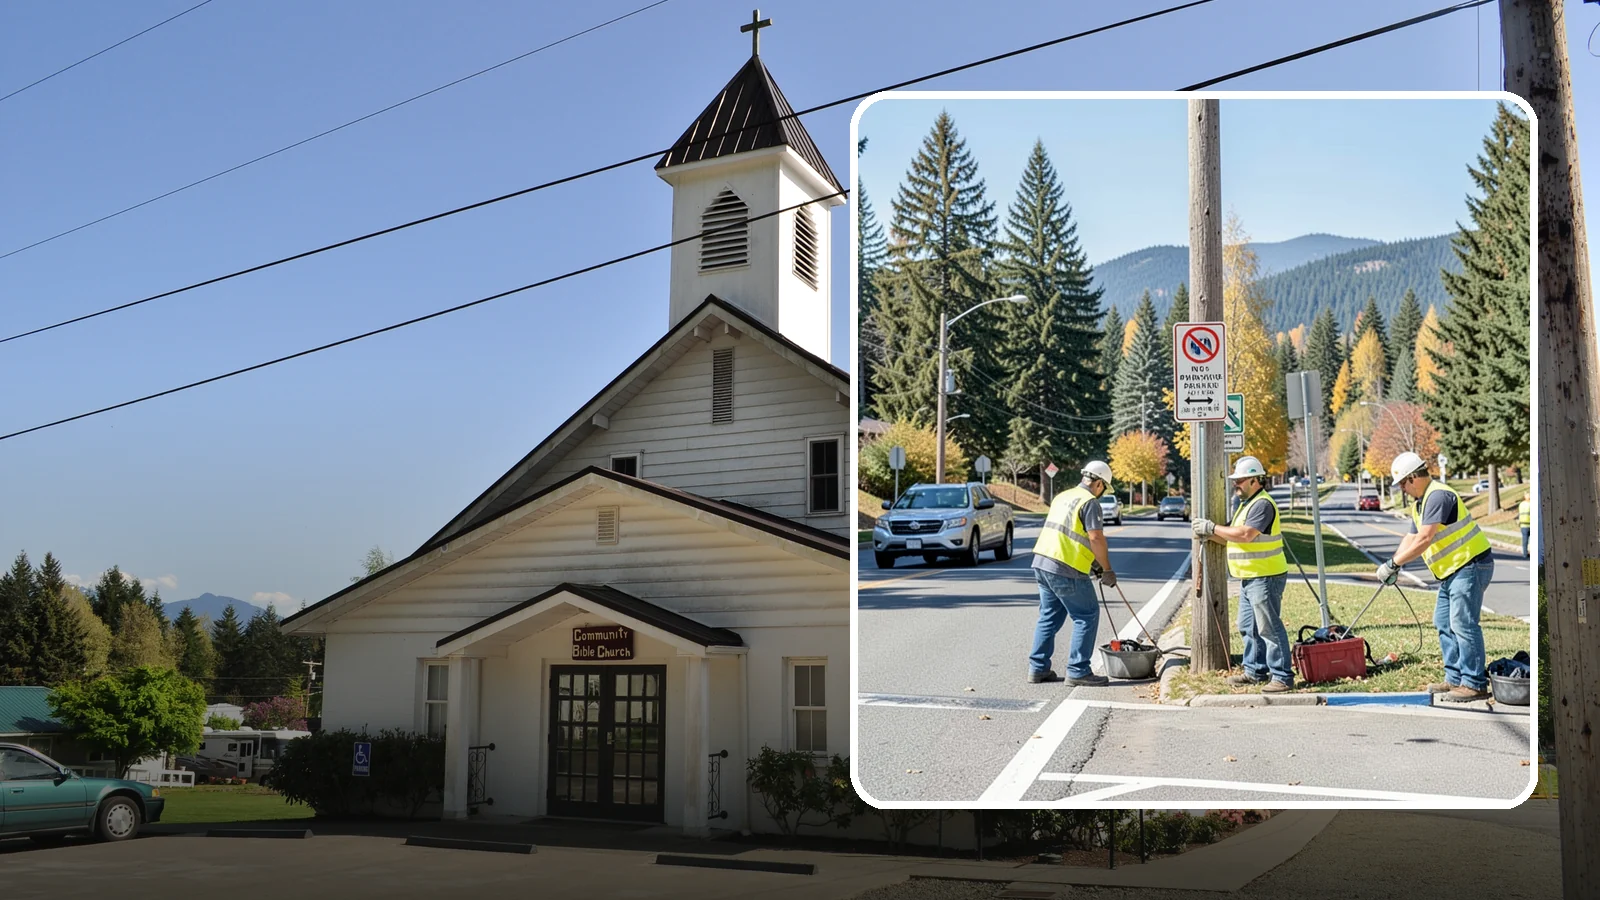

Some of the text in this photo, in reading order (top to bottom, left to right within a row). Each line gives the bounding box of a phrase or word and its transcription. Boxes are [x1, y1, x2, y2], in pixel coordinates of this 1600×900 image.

[574, 627, 628, 641] Community
[572, 645, 631, 658] Bible Church
